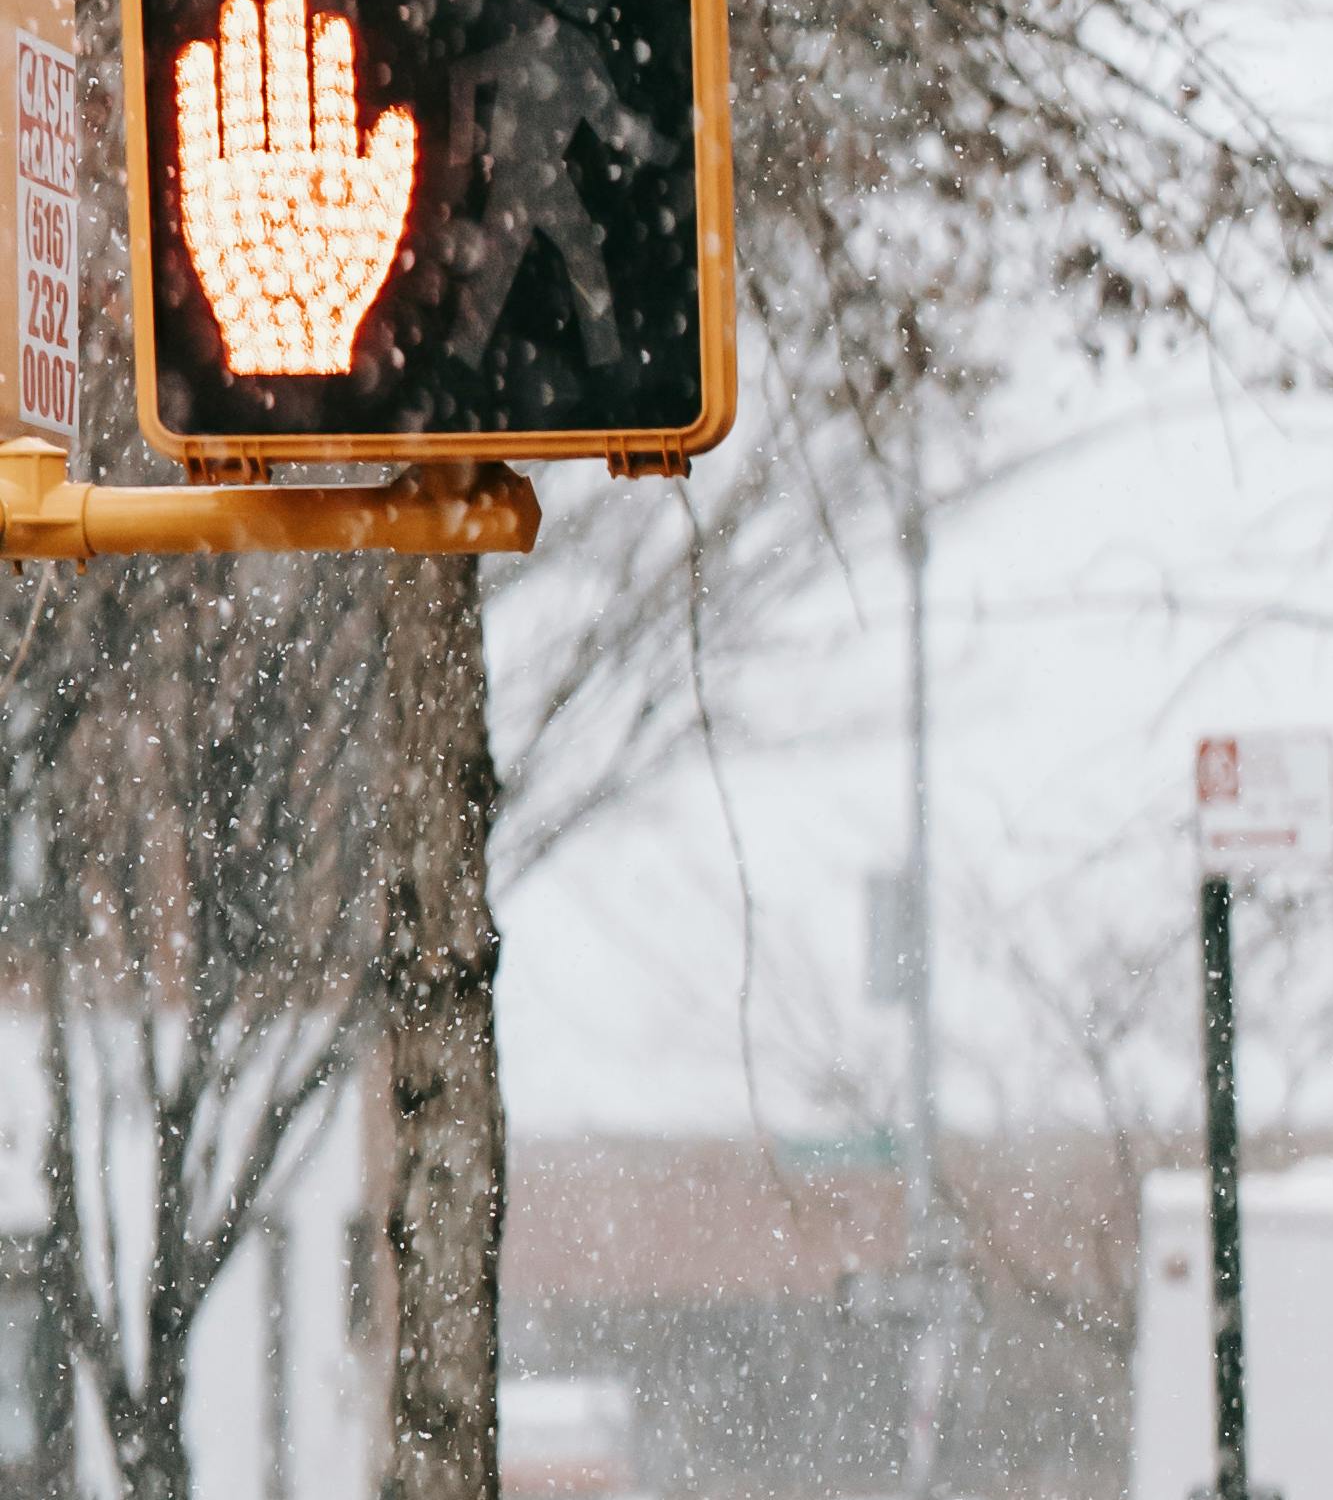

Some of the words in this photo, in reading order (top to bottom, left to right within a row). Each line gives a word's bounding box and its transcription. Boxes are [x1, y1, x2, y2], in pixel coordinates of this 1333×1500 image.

[20, 49, 76, 137] CASH
[25, 187, 72, 276] (516)
[27, 269, 69, 350] 232
[22, 344, 76, 426] 0007
